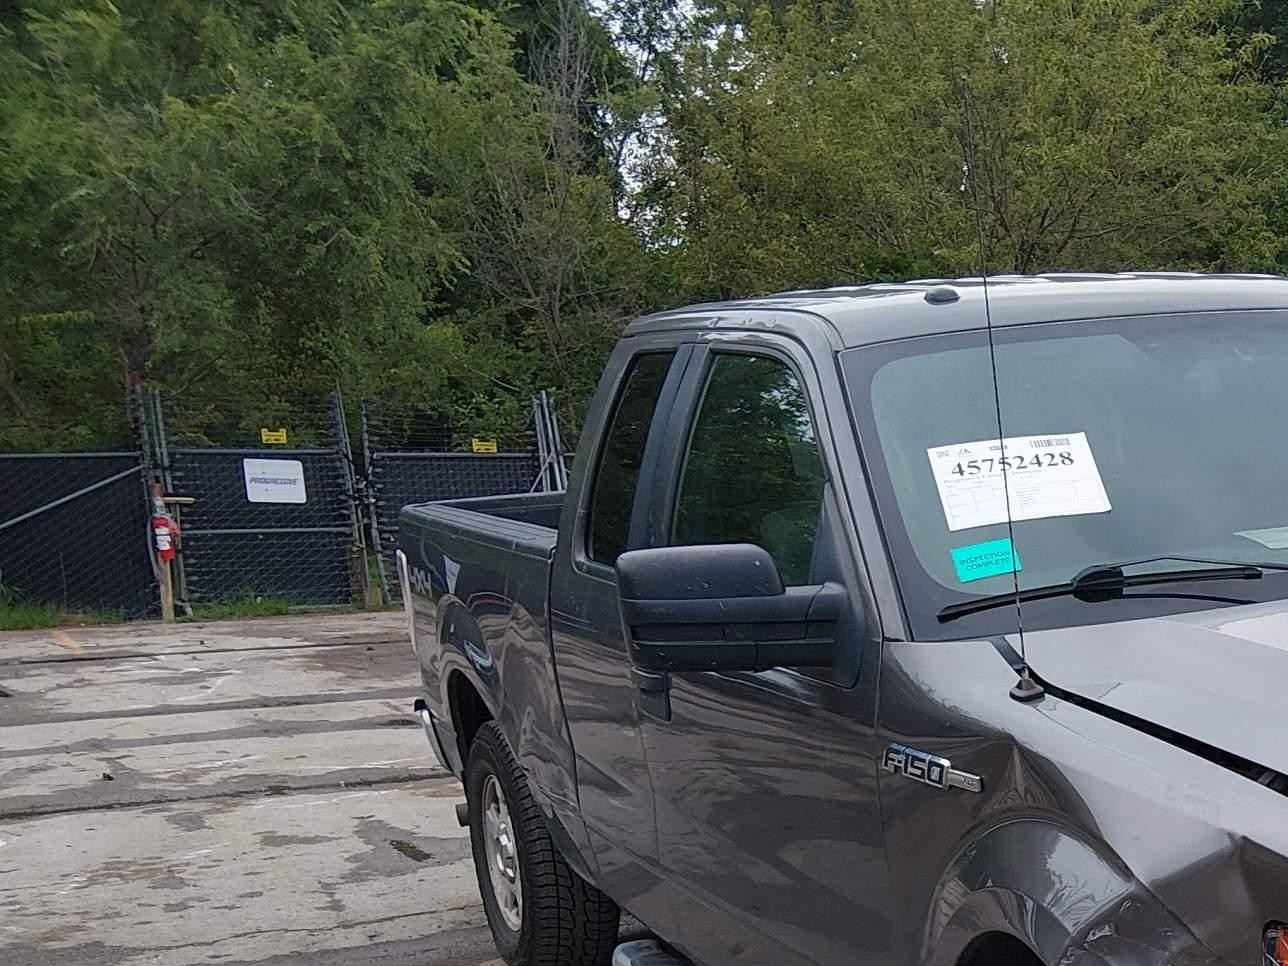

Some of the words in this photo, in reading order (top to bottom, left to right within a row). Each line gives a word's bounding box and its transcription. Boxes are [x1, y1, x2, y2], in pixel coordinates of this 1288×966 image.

[951, 451, 1074, 476] 45752428
[959, 550, 1010, 566] INSPECTION
[966, 557, 1011, 571] COMPLETE
